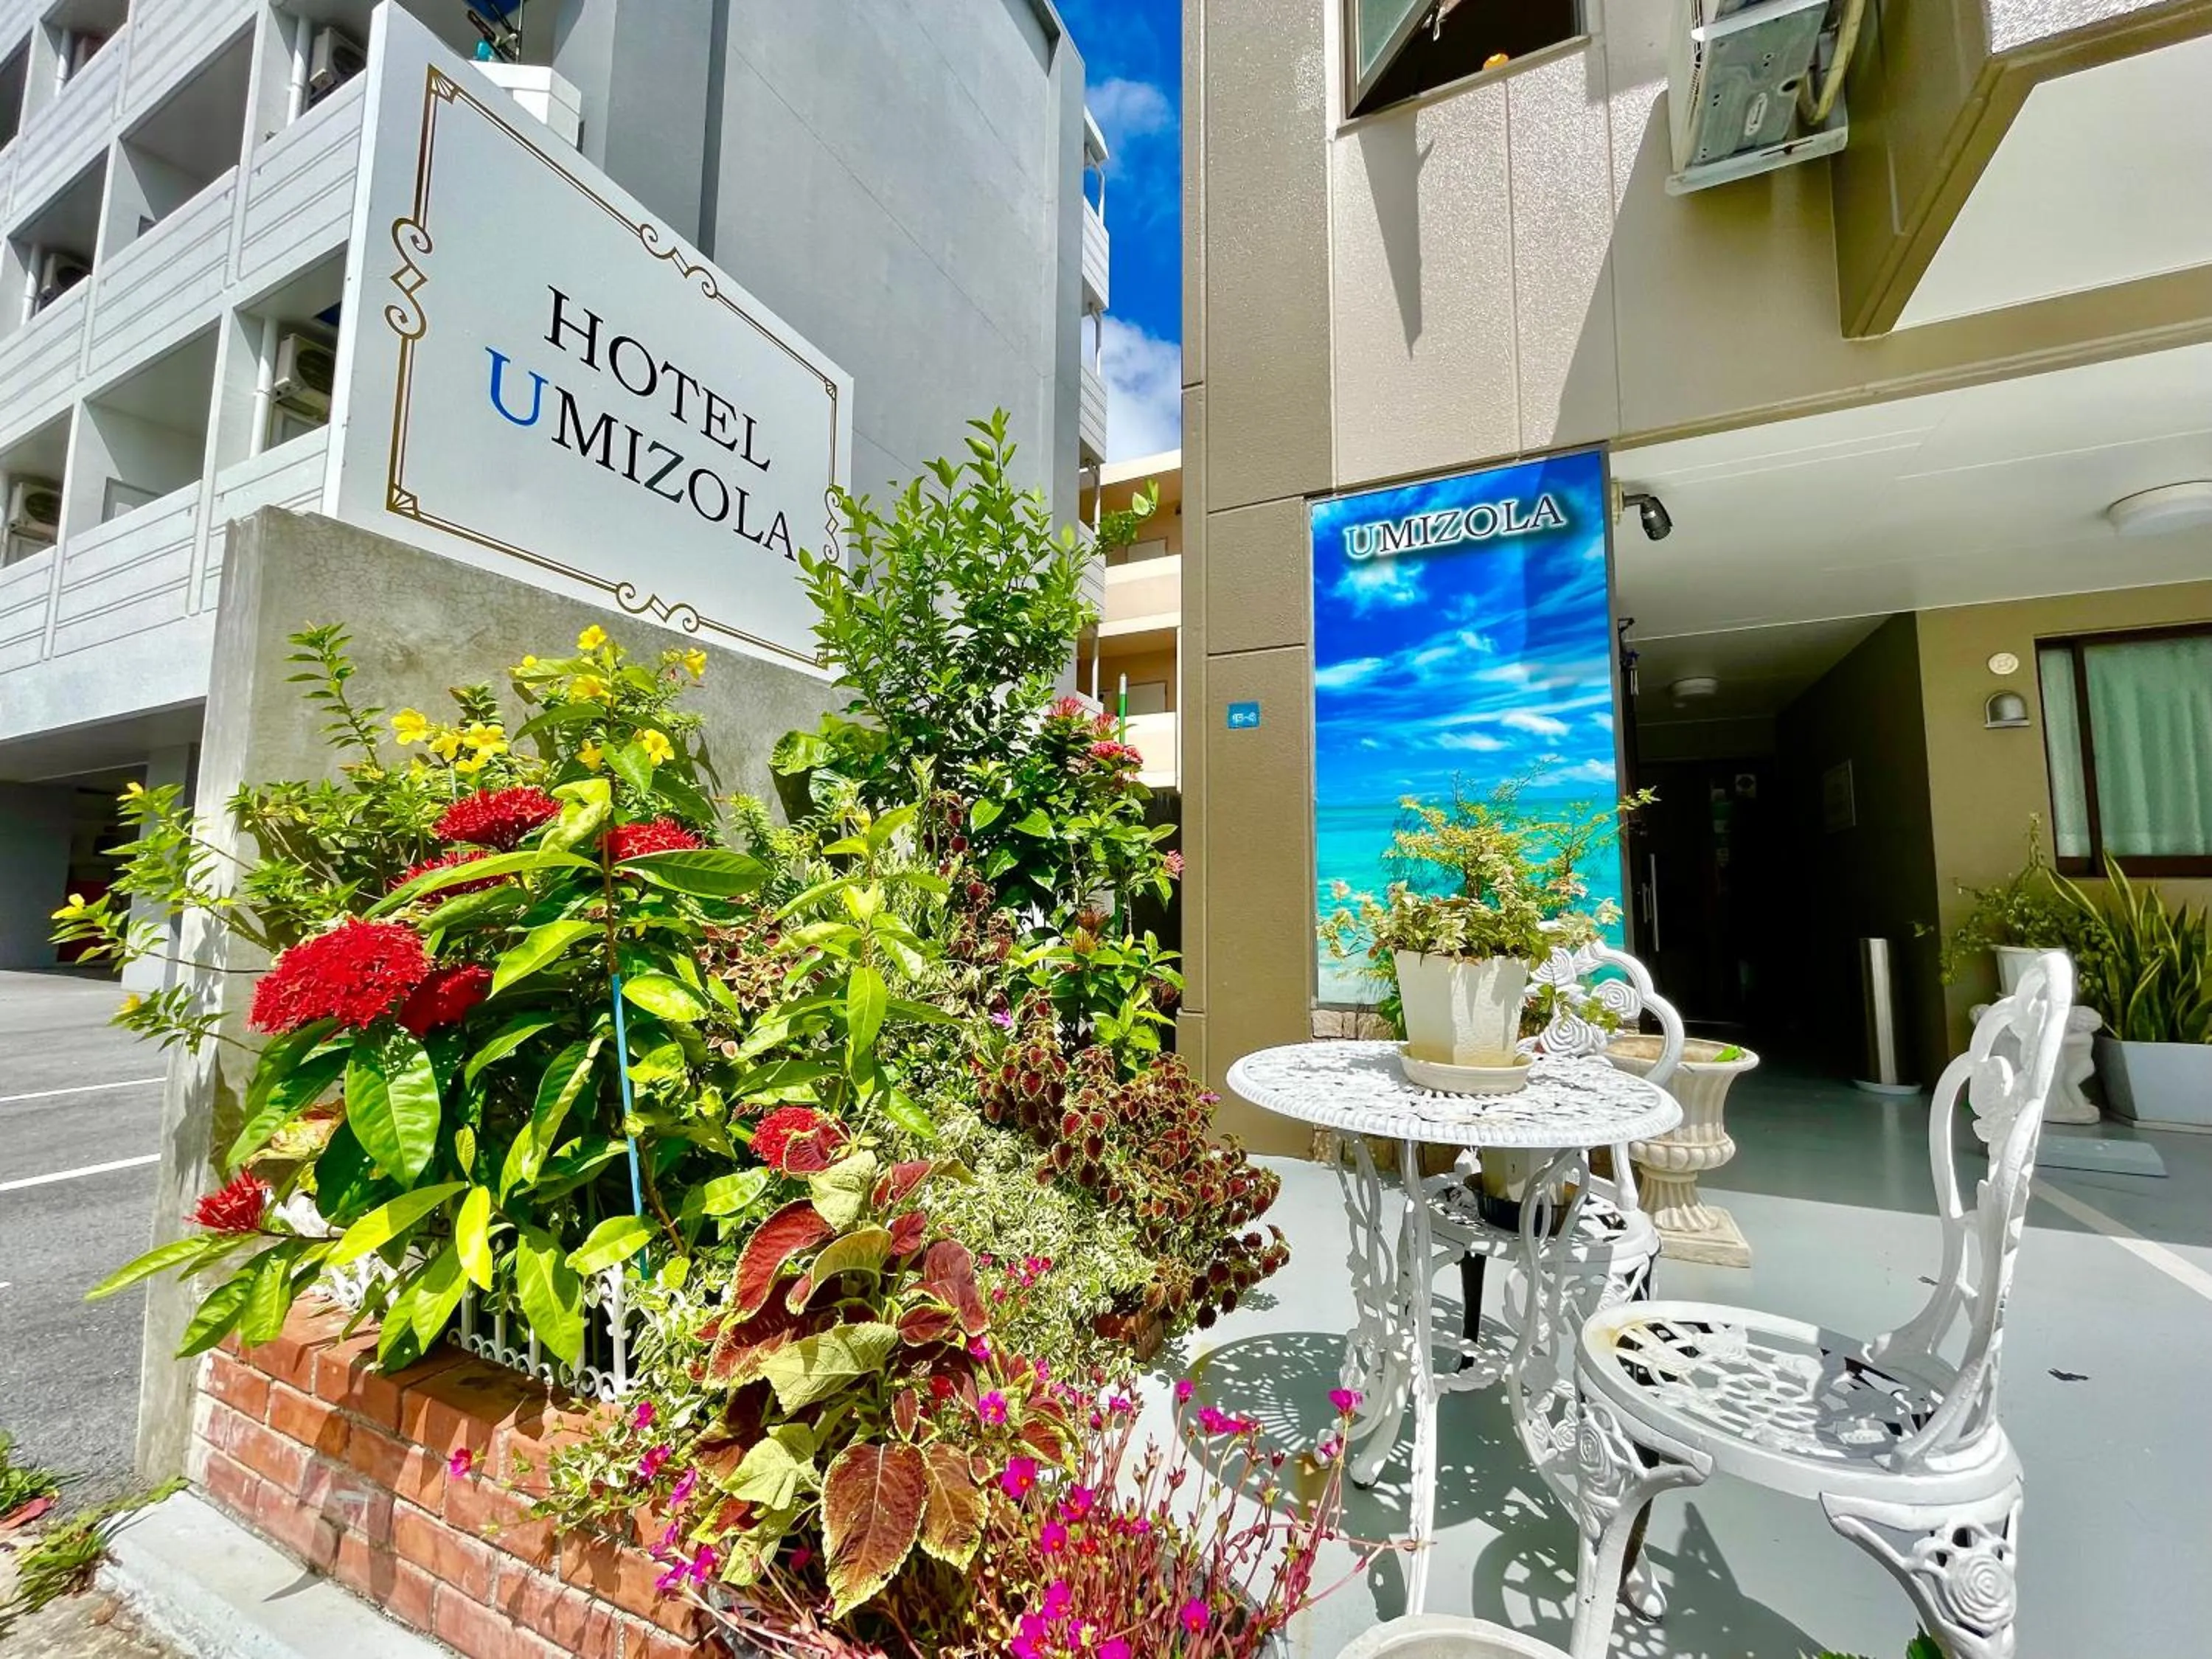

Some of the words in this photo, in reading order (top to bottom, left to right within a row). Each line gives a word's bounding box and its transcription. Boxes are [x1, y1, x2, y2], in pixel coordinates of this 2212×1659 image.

[484, 346, 797, 563] UMIZOLA
[543, 284, 771, 472] HOTEL
[1344, 494, 1565, 557] UMIZOLA
